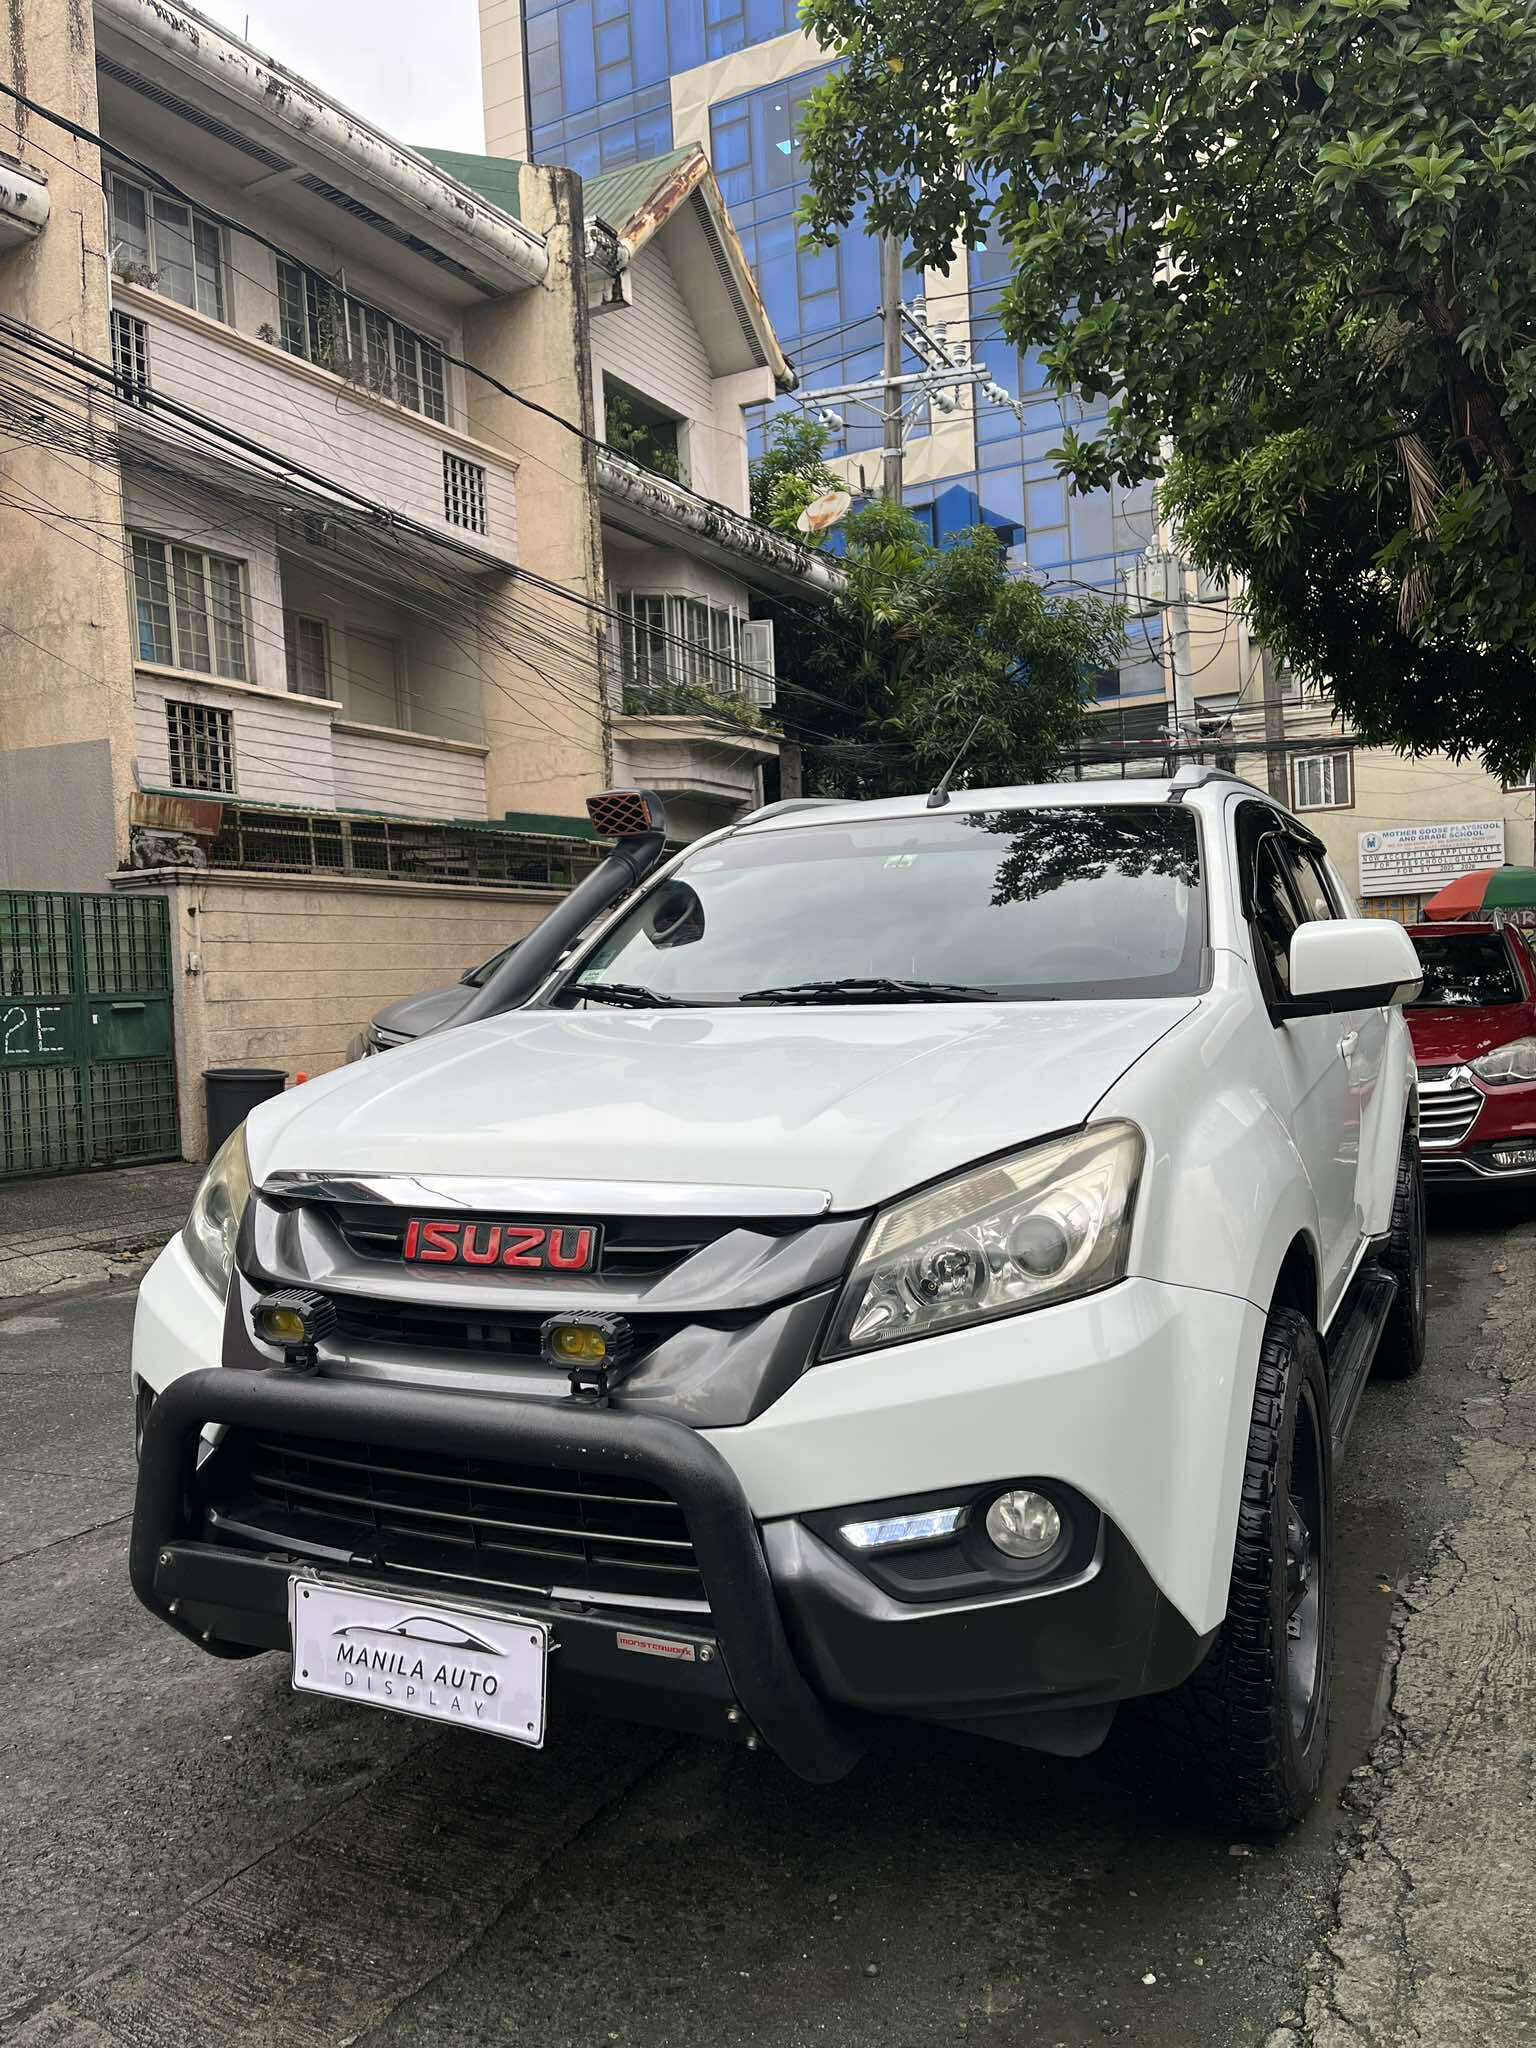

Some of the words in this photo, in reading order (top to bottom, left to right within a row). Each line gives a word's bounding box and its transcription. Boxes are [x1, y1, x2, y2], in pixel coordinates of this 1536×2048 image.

[1382, 829, 1417, 838] MOTHER
[1418, 826, 1449, 835] GOOSE
[1450, 822, 1501, 832] PLAYSKOOL
[1449, 830, 1485, 838] SCHOOL
[1383, 850, 1435, 860] ACCEPTING
[1441, 846, 1501, 855] APPLICANTS
[1396, 857, 1447, 867] PRESCHOOL
[404, 1221, 592, 1270] ISUZU
[336, 1642, 424, 1680] MANILA
[433, 1664, 498, 1696] AUTO
[343, 1671, 485, 1717] DISPLAY
